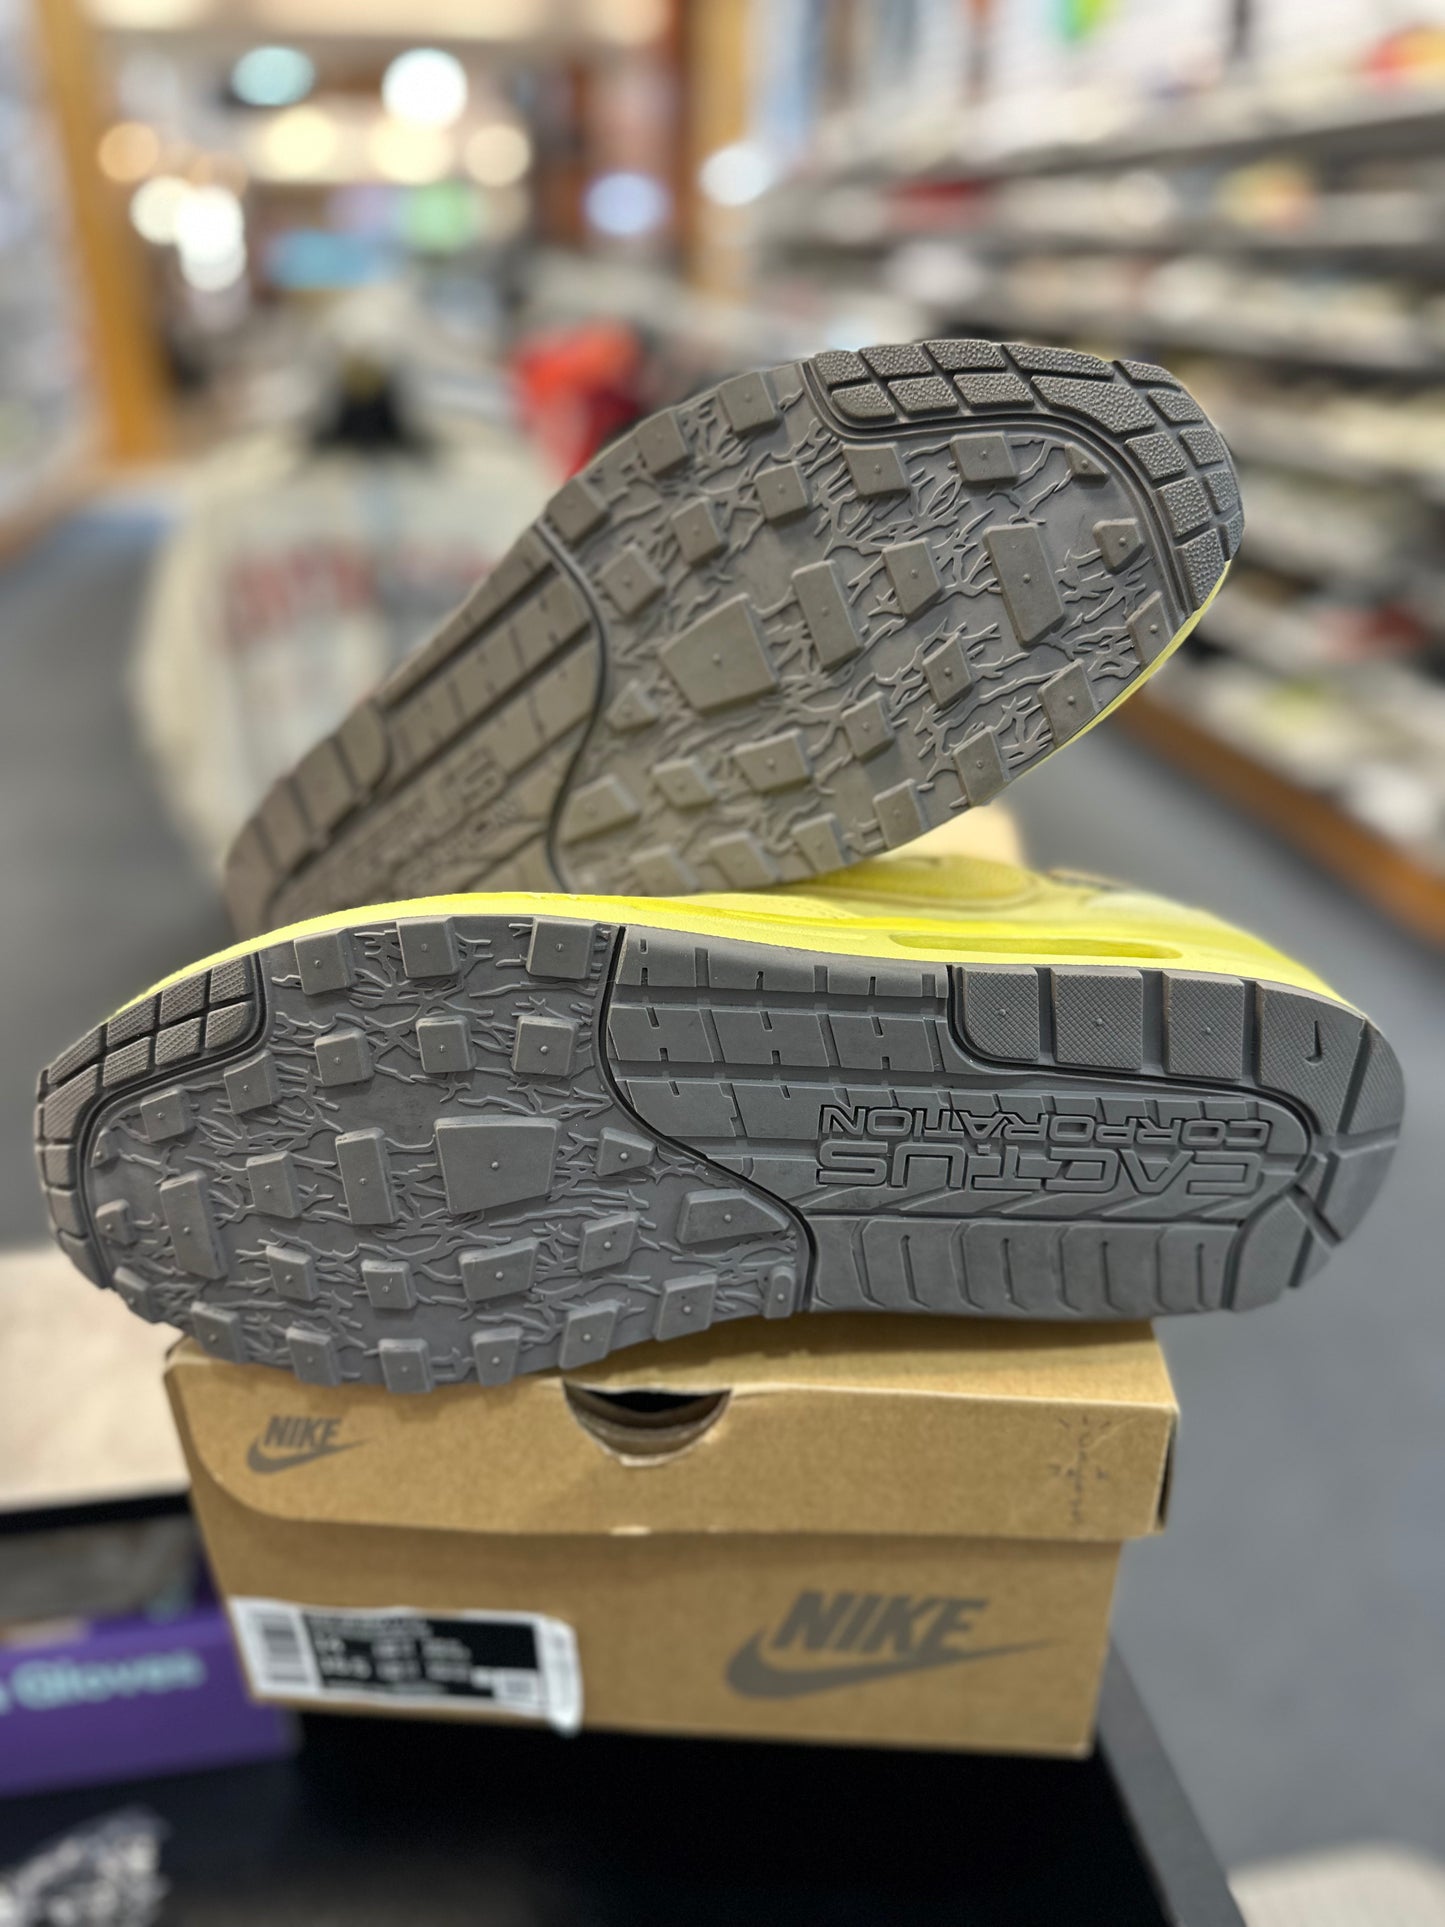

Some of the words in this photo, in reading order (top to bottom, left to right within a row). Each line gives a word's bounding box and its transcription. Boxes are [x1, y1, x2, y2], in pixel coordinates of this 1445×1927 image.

[817, 1104, 1272, 1148] CORPORATION
[815, 1139, 1264, 1196] CACTUS
[264, 1415, 342, 1450] NIKE
[772, 1590, 990, 1654] NIKE
